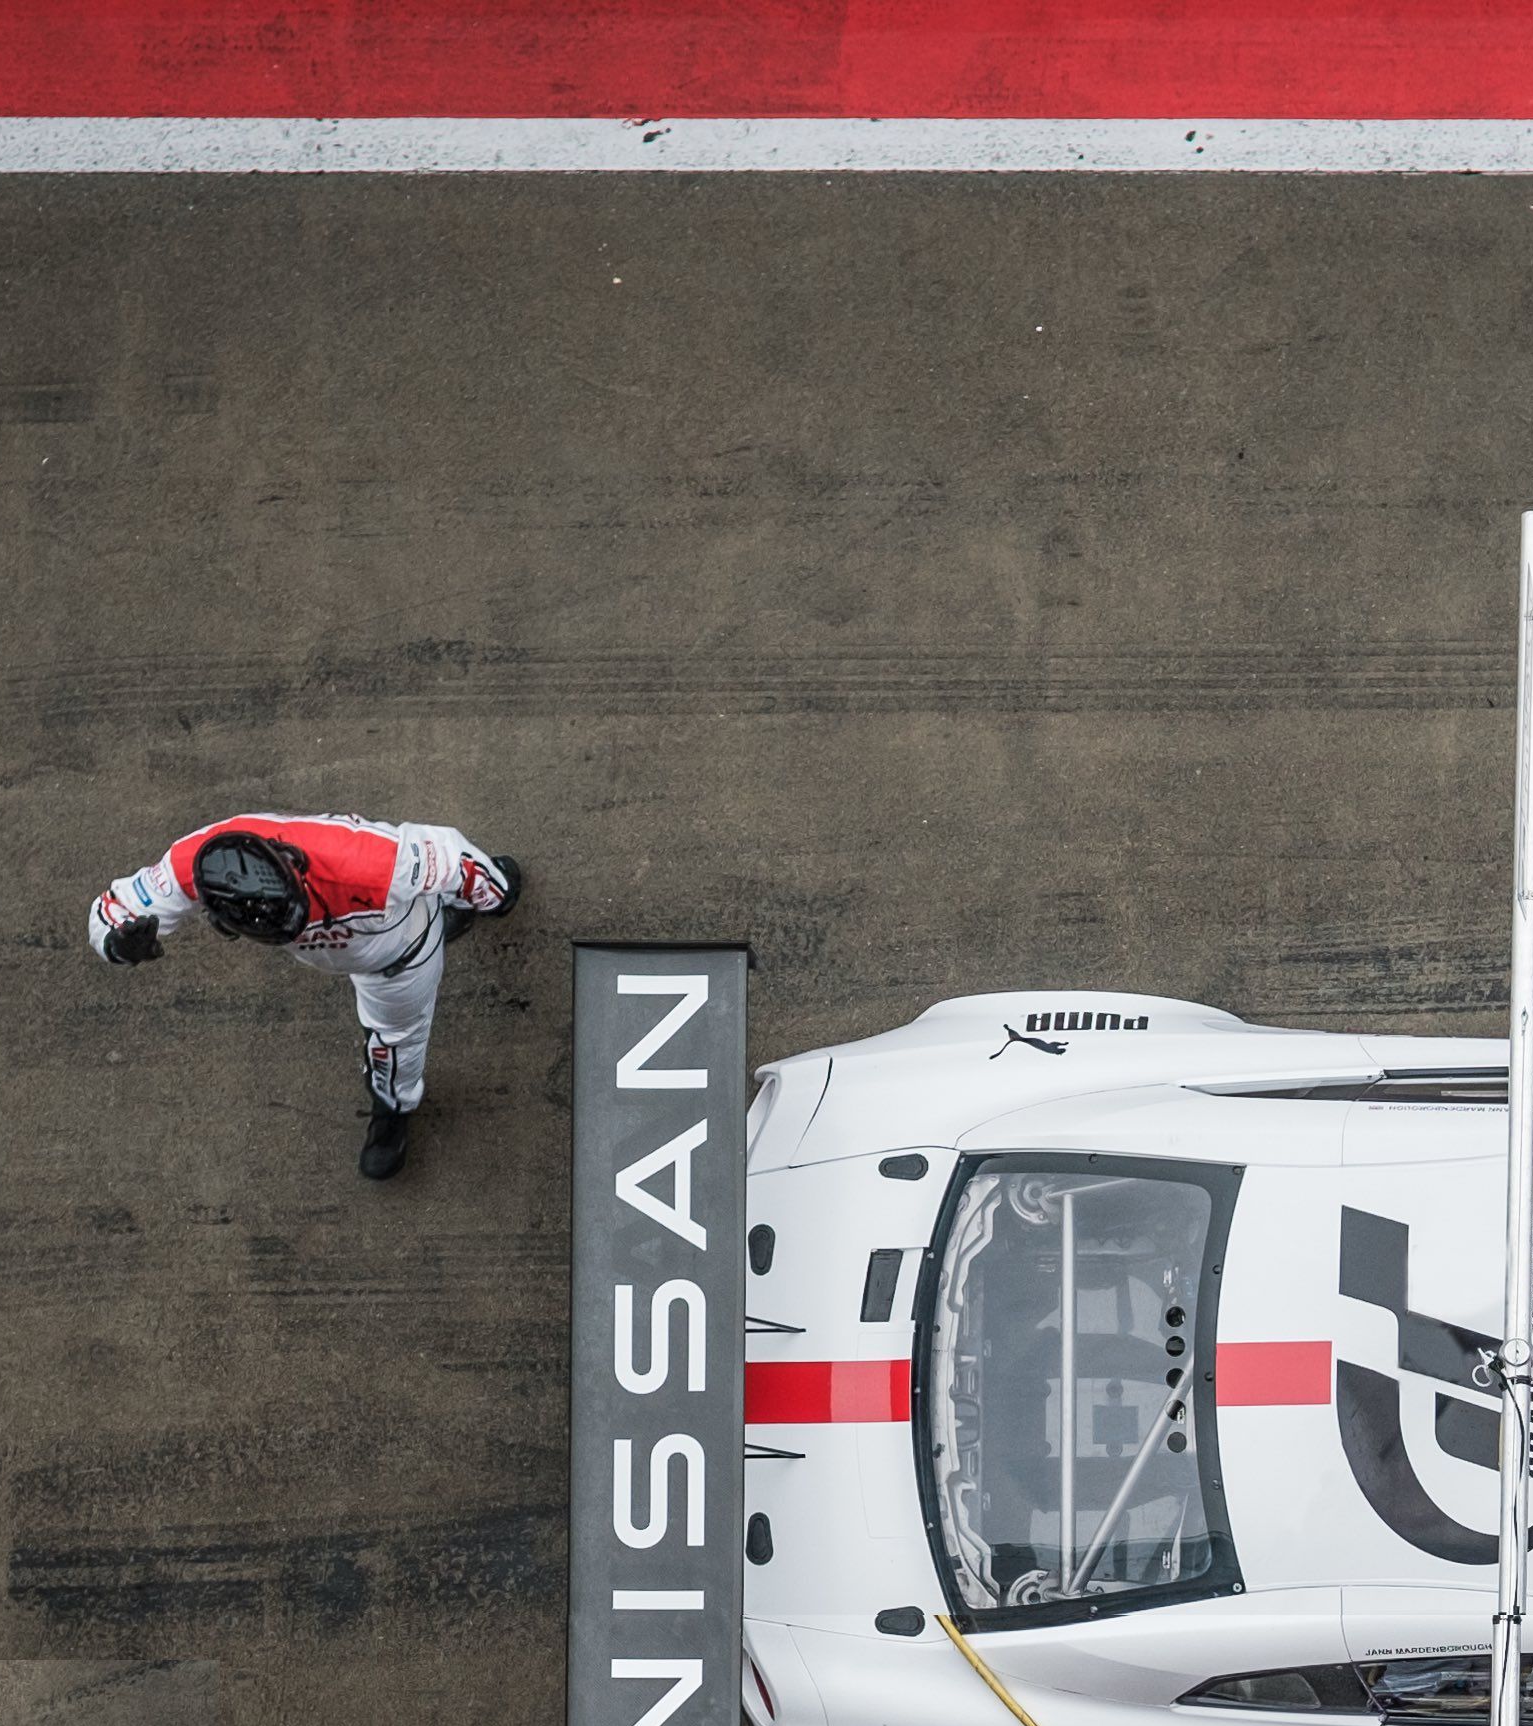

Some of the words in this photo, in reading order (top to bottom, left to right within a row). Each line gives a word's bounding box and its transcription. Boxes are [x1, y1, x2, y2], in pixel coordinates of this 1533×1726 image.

[1026, 1011, 1149, 1032] PUMA
[1366, 1648, 1393, 1656] JANN
[1395, 1643, 1493, 1655] MARDENBOROUGH
